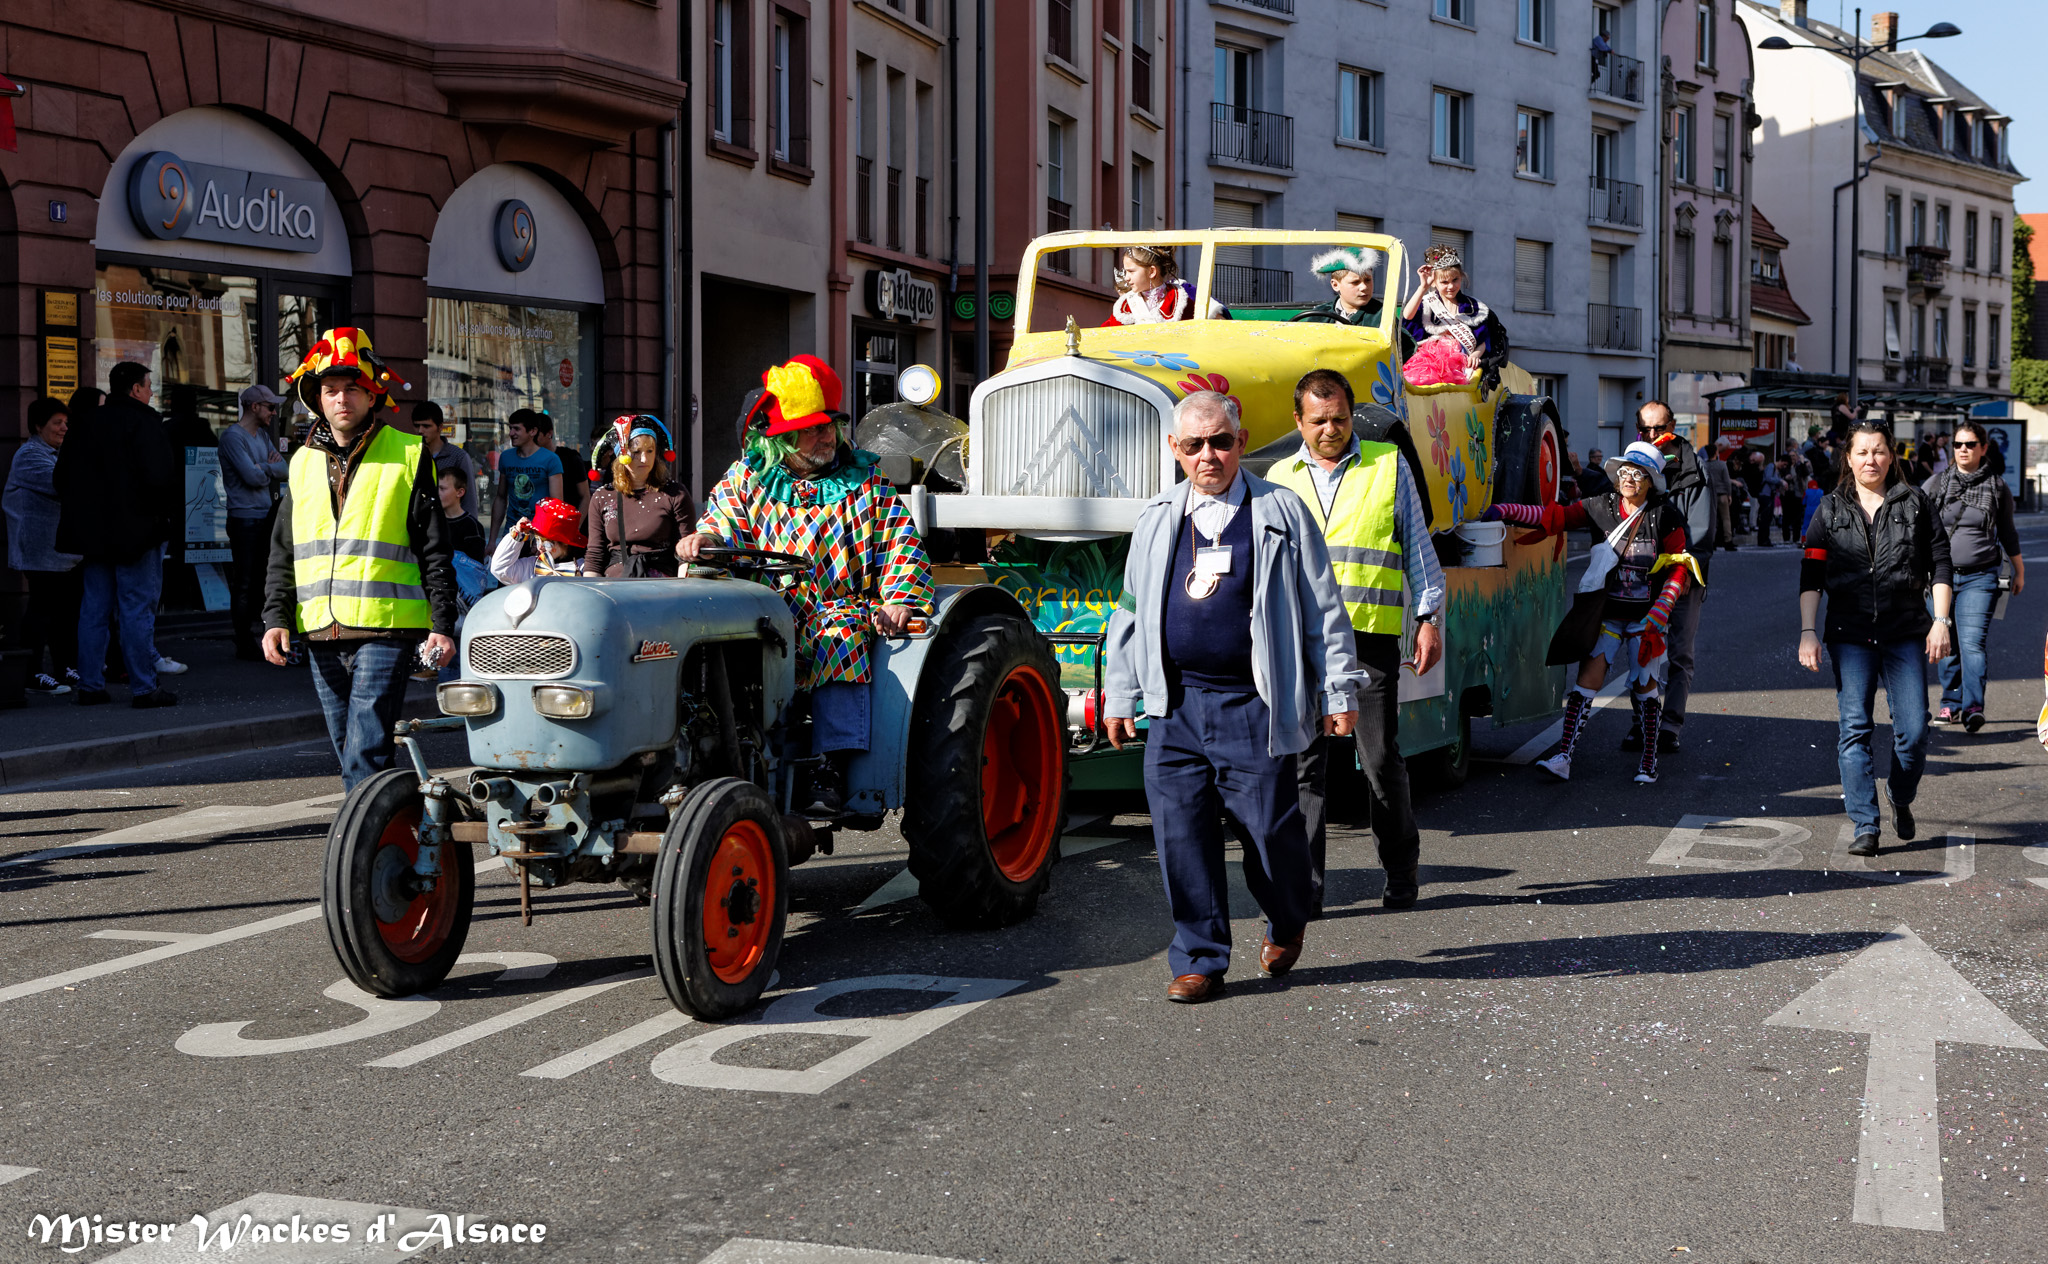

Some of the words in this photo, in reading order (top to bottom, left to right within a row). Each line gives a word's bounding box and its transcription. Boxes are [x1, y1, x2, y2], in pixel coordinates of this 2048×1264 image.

[198, 180, 316, 239] Audika
[96, 287, 112, 302] les
[116, 289, 163, 306] solutions
[166, 294, 190, 309] pour
[192, 295, 237, 312] l'audition
[470, 322, 503, 336] solutions
[504, 325, 521, 338] pour
[1721, 419, 1757, 428] ARRIVAGES
